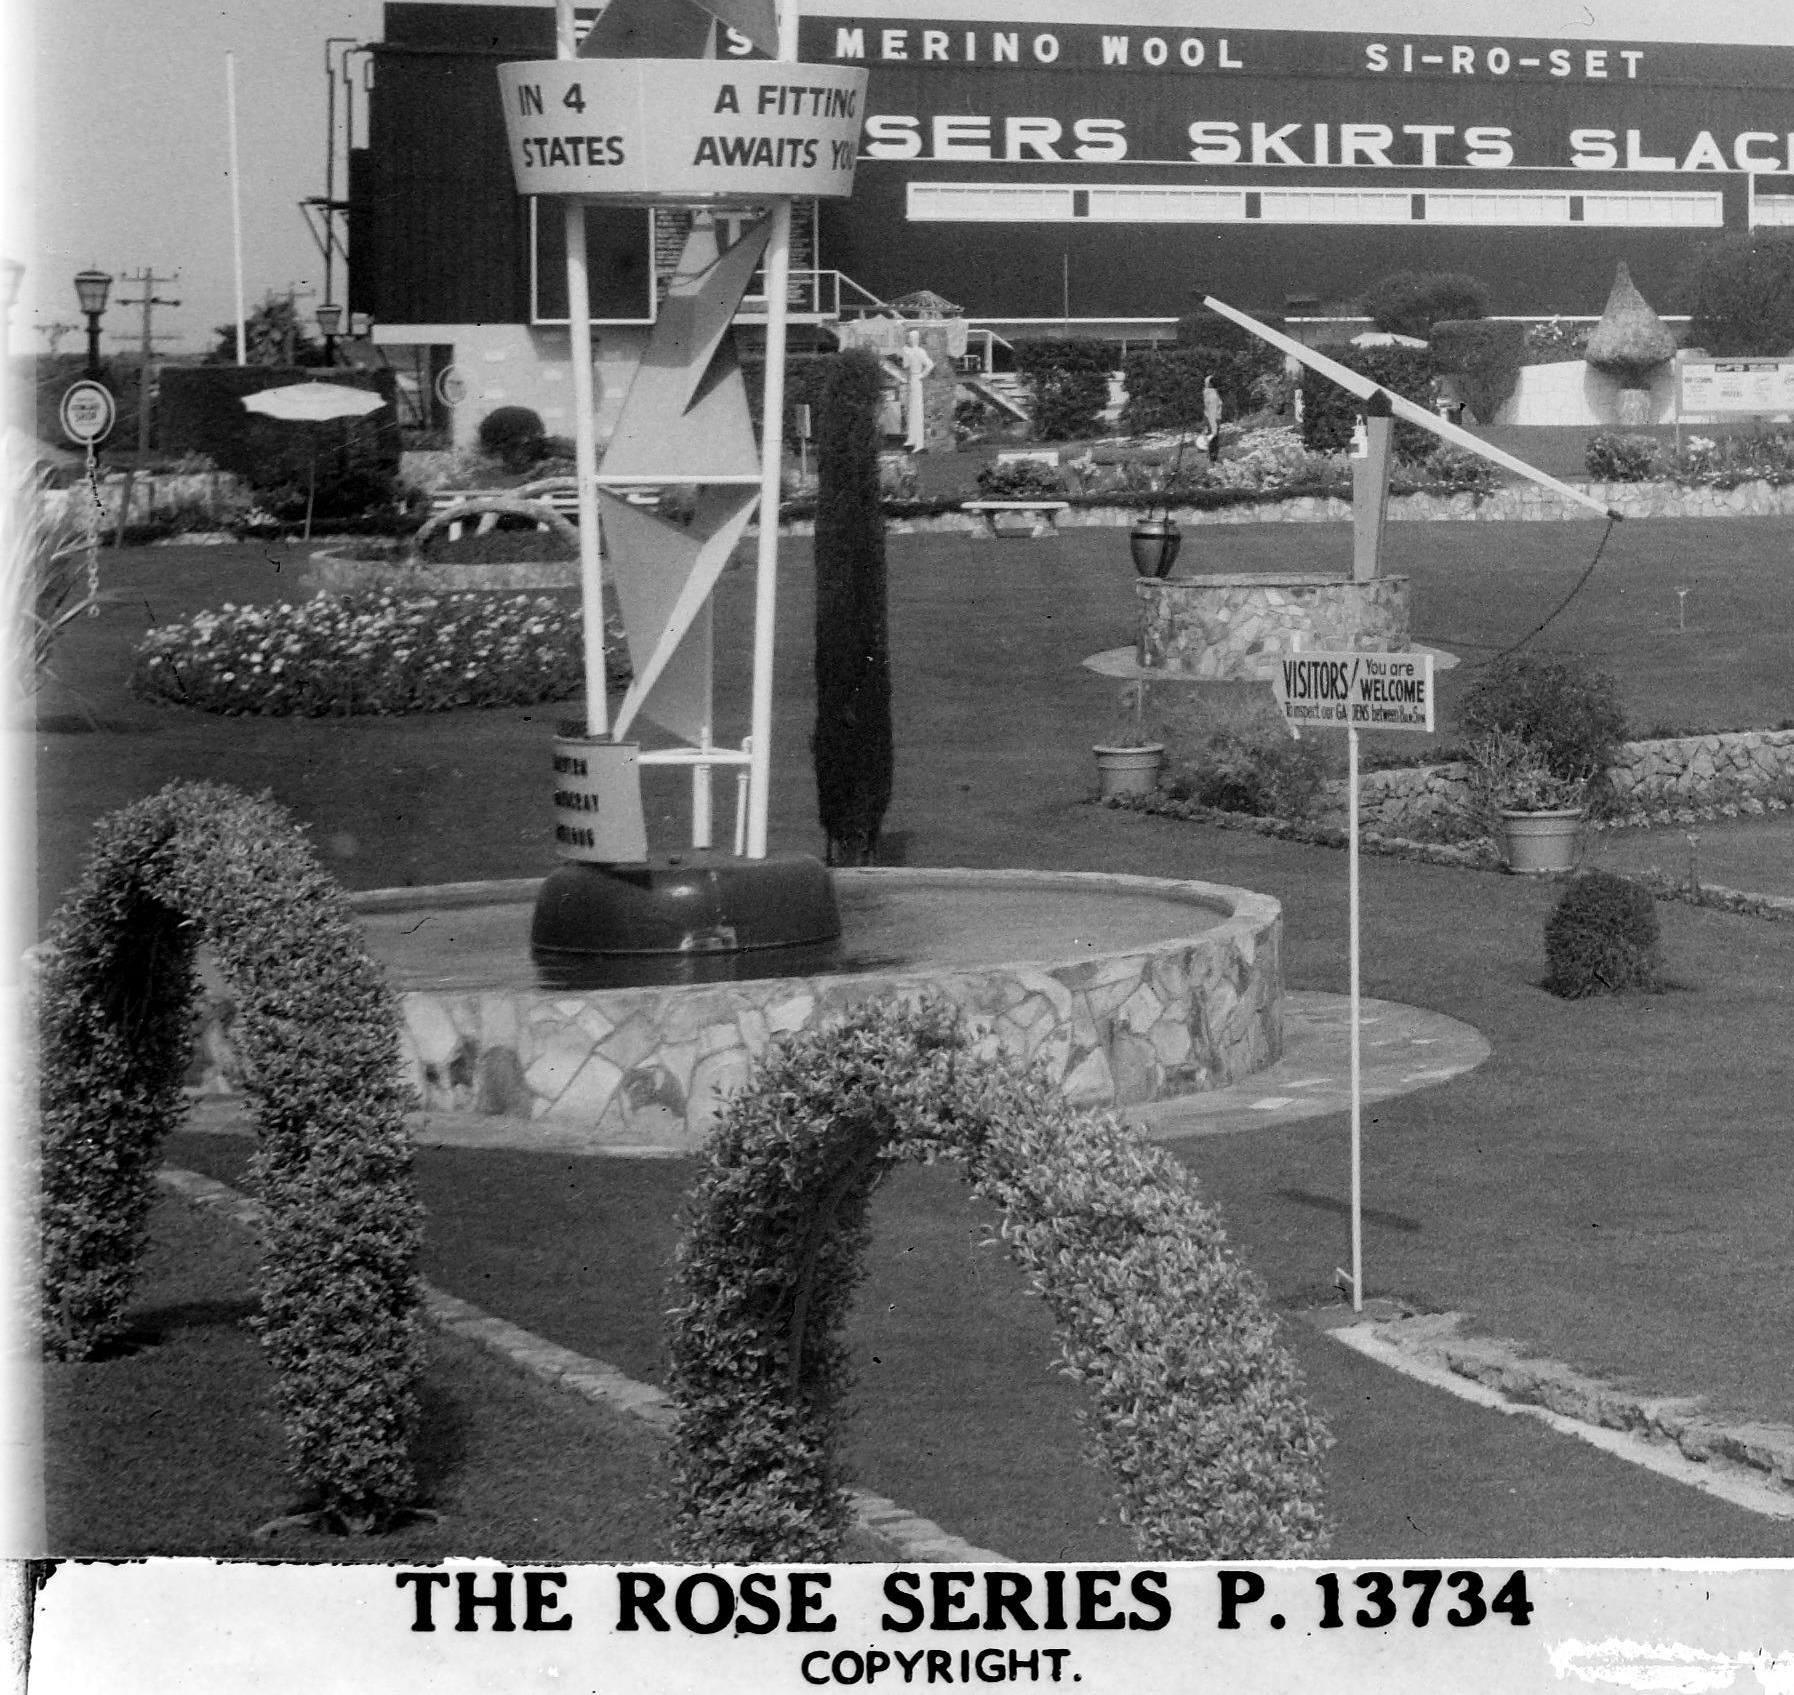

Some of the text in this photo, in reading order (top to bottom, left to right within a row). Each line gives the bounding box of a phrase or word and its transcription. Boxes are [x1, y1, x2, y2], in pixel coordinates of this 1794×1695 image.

[835, 27, 1243, 70] MERINO WOOL
[1365, 43, 1645, 79] SI-RO-SET
[518, 82, 586, 117] IN 4
[713, 83, 856, 119] A FITTING
[522, 135, 625, 168] STATES
[693, 135, 818, 169] AWAITS
[864, 114, 1128, 162] SERS
[1188, 121, 1515, 168] SKIRTS
[1366, 658, 1414, 676] You are
[1360, 678, 1425, 703] WELCOME
